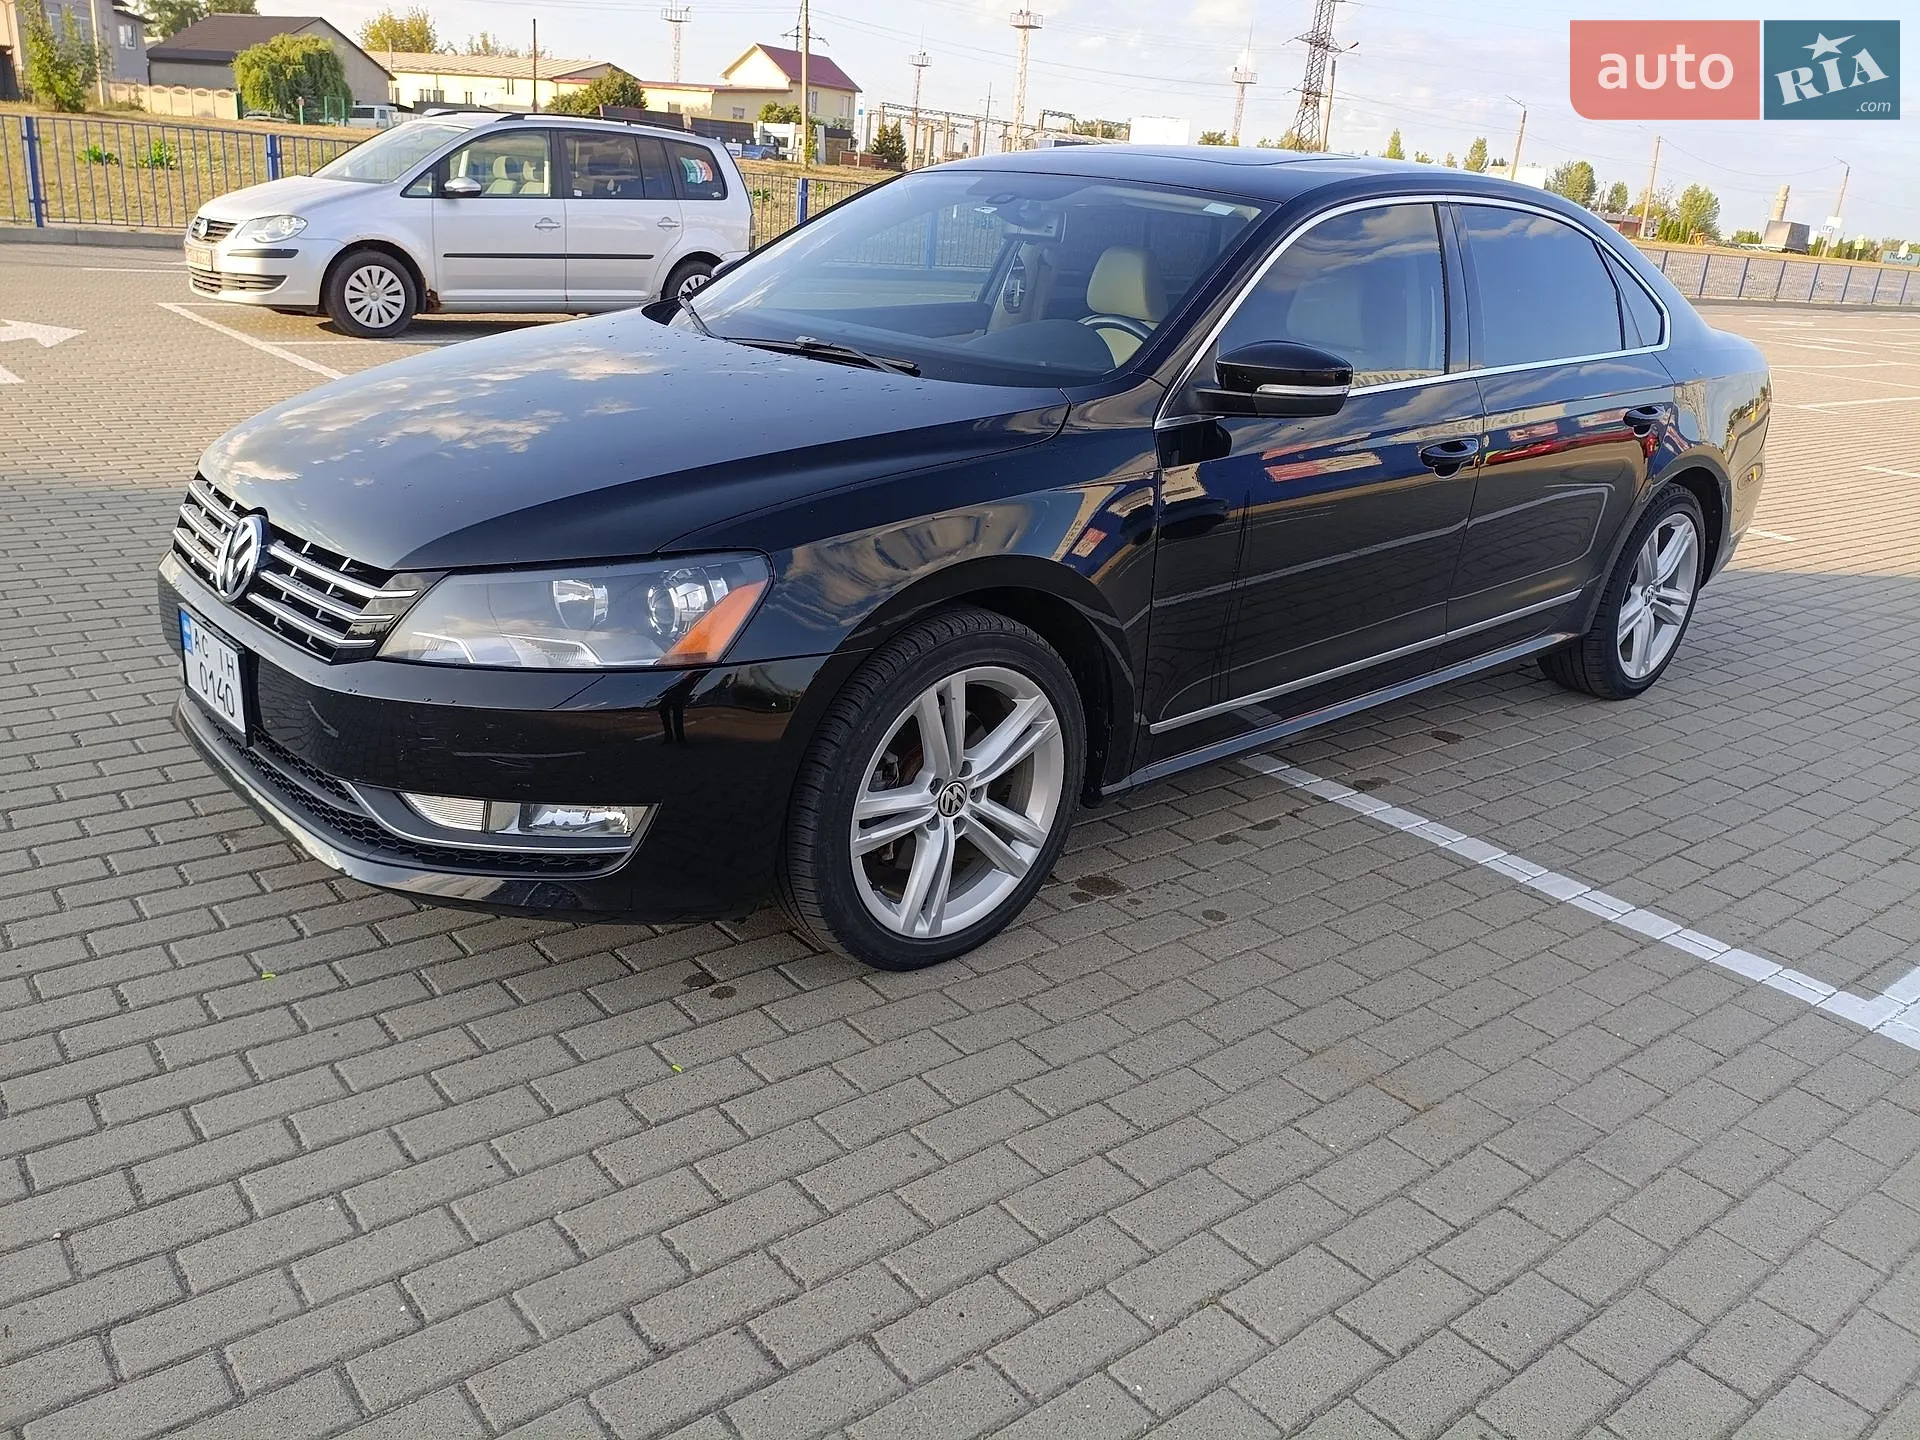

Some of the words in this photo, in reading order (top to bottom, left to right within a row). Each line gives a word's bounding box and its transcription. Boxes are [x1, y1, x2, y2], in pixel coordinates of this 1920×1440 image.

[194, 628, 208, 658] AC
[219, 648, 235, 680] IH
[200, 661, 235, 717] 0140
